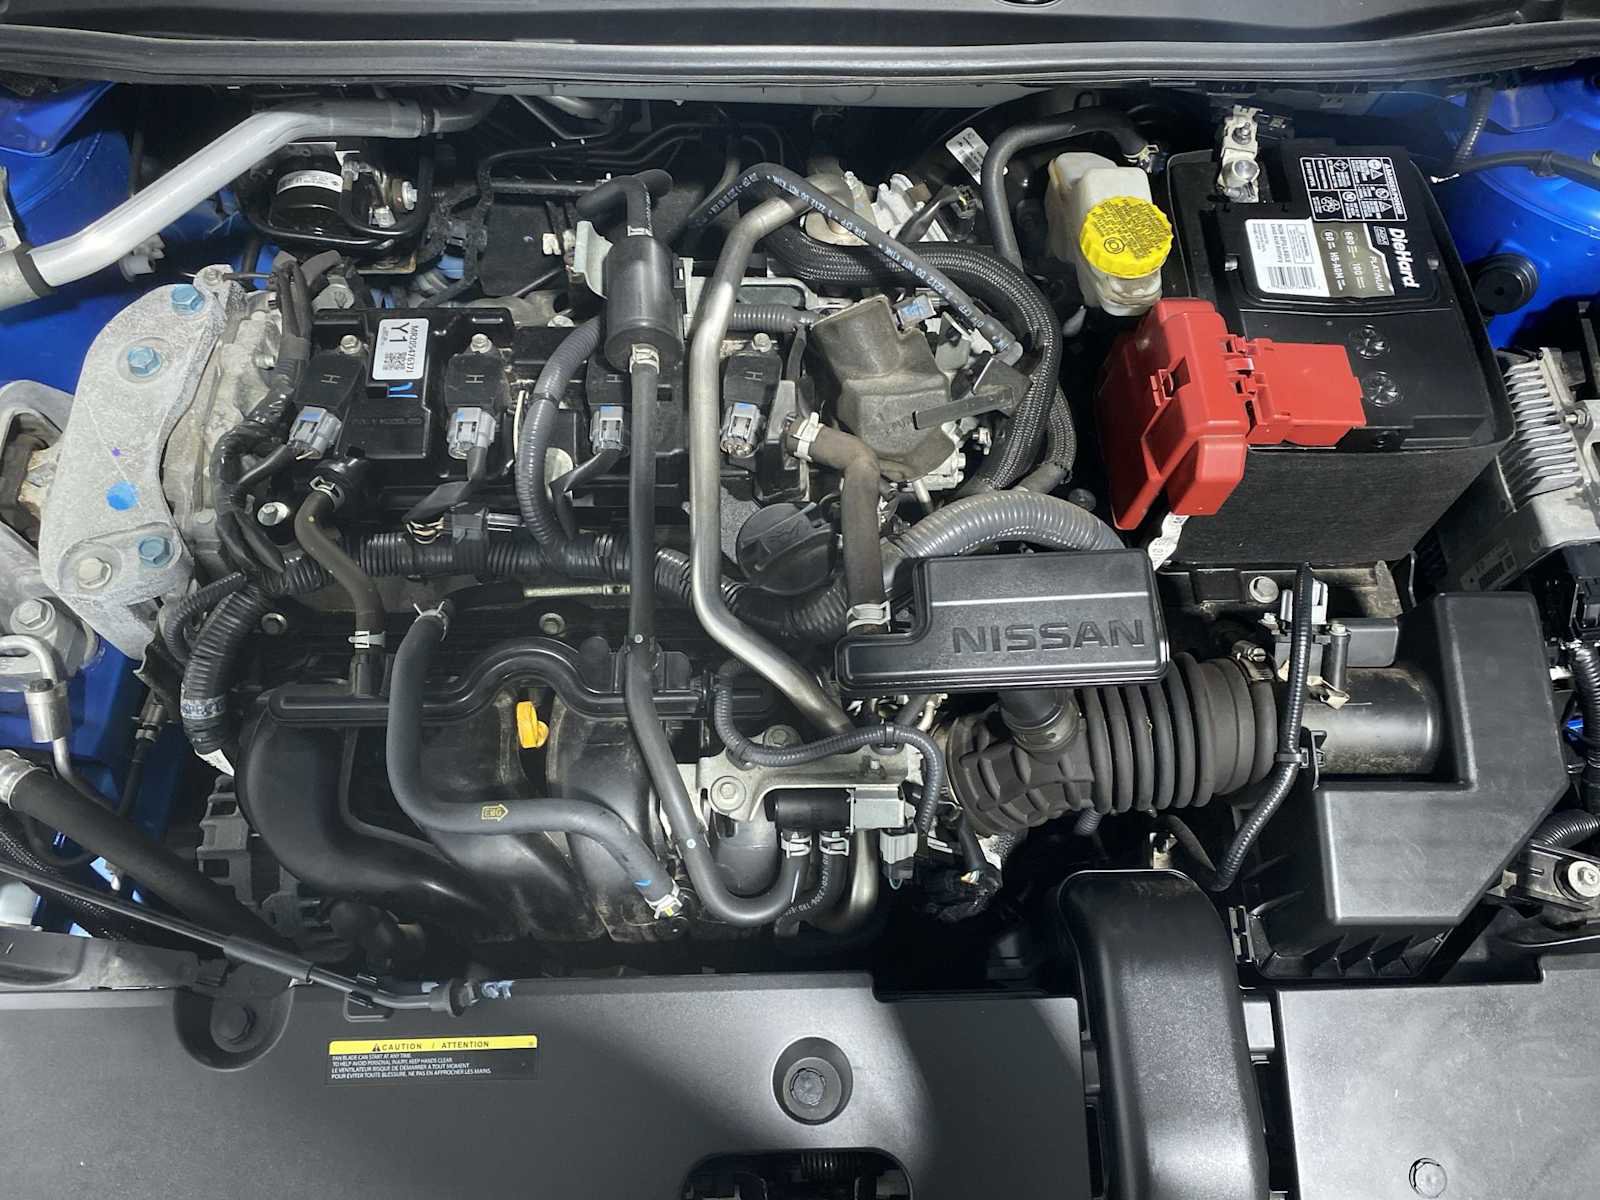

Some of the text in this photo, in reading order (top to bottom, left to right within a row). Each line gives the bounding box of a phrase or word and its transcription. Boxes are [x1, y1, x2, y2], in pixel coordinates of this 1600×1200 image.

[1352, 263, 1362, 276] 100
[1388, 227, 1420, 288] DieHard
[1369, 255, 1385, 291] PLATINUM
[389, 321, 410, 342] Y1
[952, 618, 1145, 655] NISSAN
[382, 1043, 422, 1051] CAUTION
[441, 1041, 489, 1050] ATTENTION
